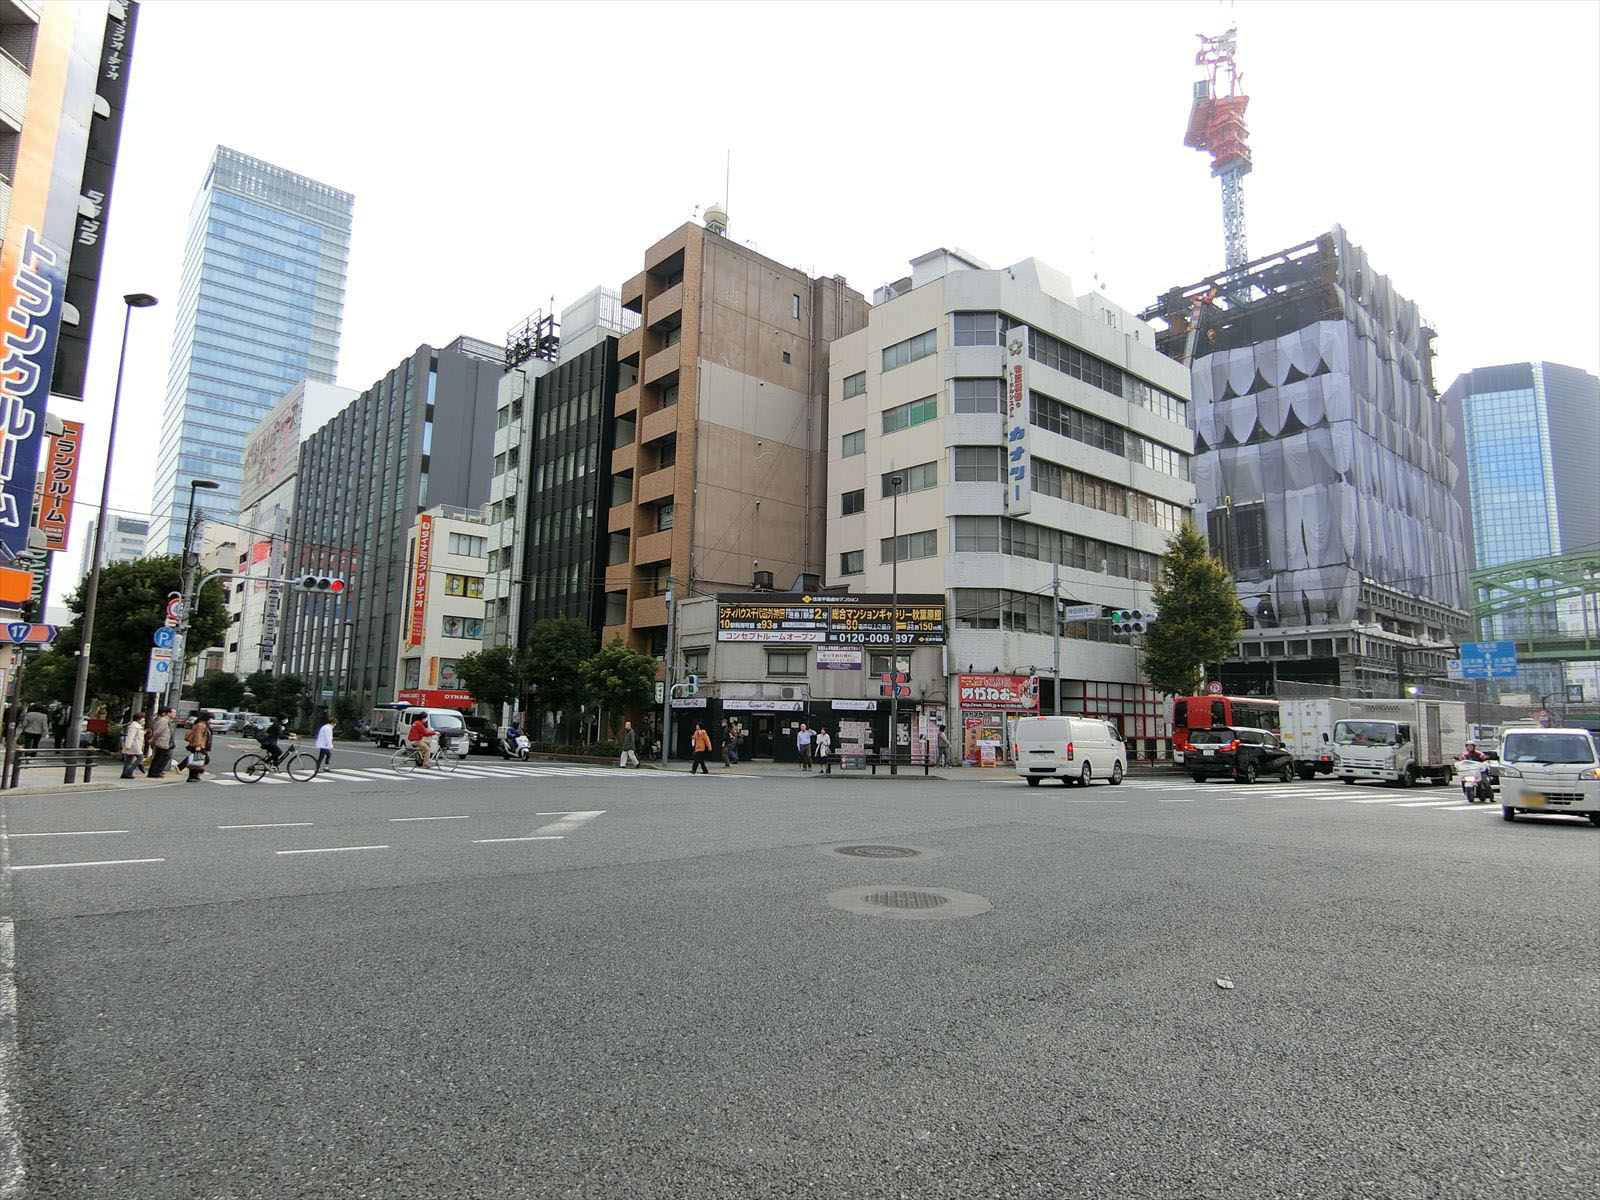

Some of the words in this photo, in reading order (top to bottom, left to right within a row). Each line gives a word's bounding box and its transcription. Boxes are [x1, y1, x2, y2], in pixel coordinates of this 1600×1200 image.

[46, 425, 78, 524] トランクルーム
[10, 625, 27, 638] 17
[726, 632, 817, 640] コンセプトルームオープン
